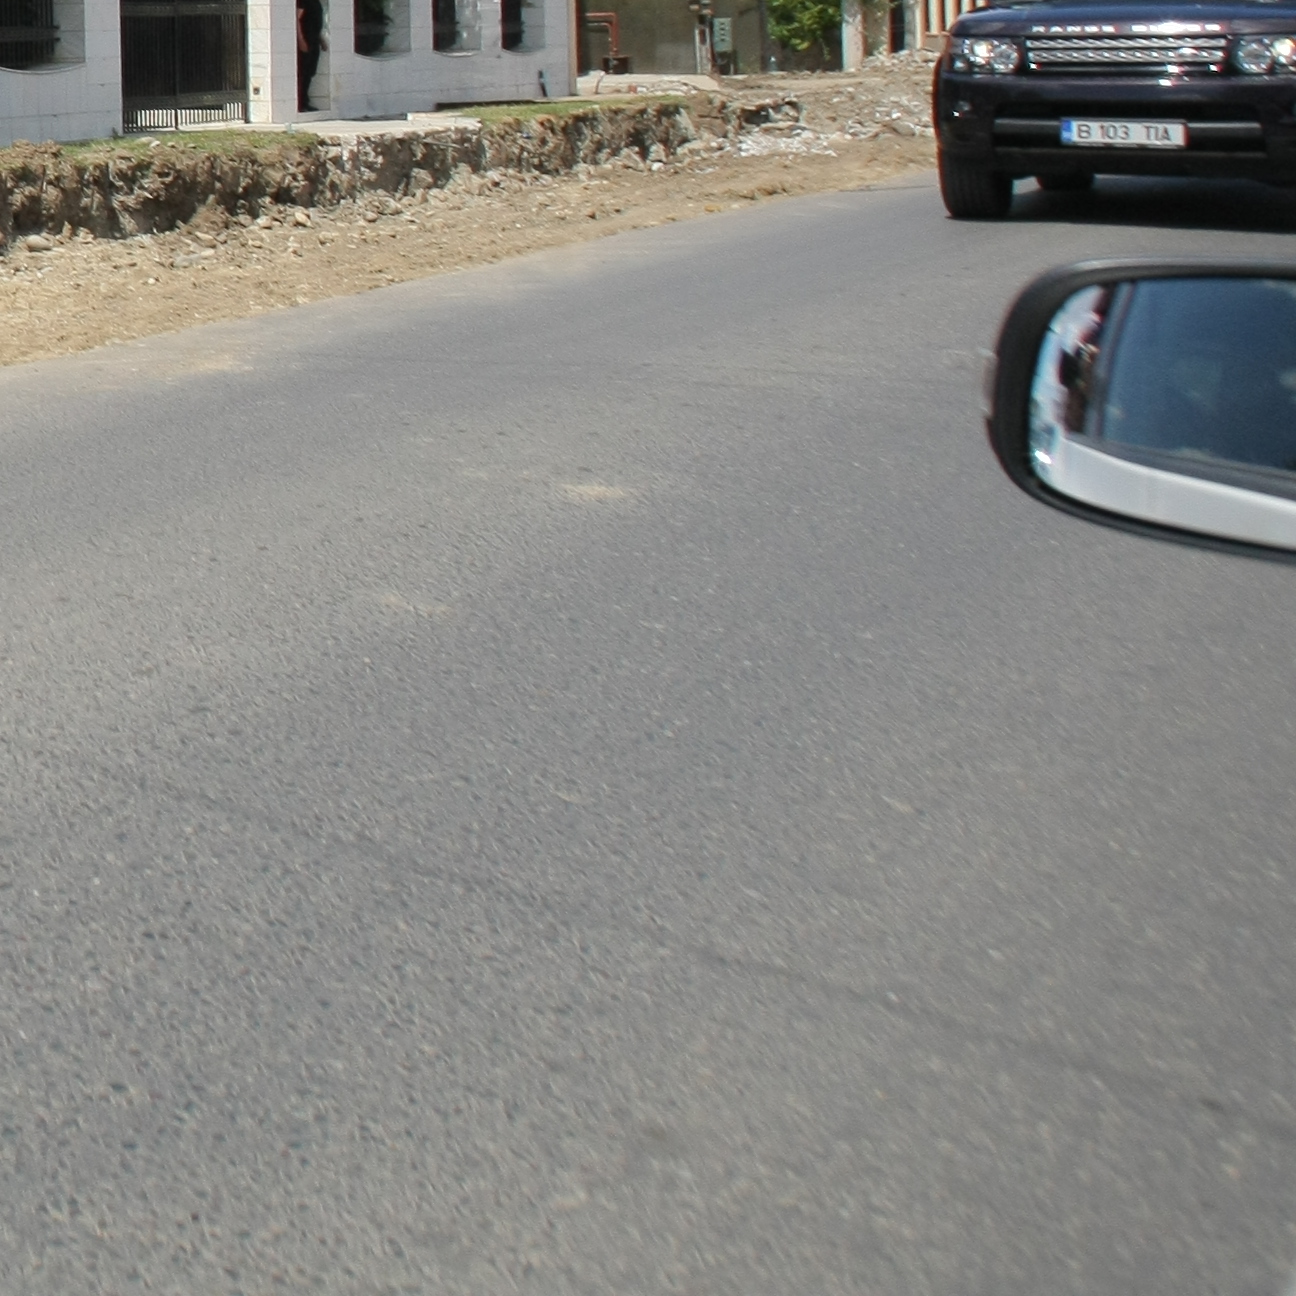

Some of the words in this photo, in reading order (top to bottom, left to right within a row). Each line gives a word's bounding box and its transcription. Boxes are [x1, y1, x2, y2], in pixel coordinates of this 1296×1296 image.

[1031, 24, 1115, 33] RANGE
[1130, 23, 1222, 33] ROER
[1077, 123, 1091, 139] B
[1099, 123, 1130, 140] 103
[1143, 125, 1172, 142] TIA
